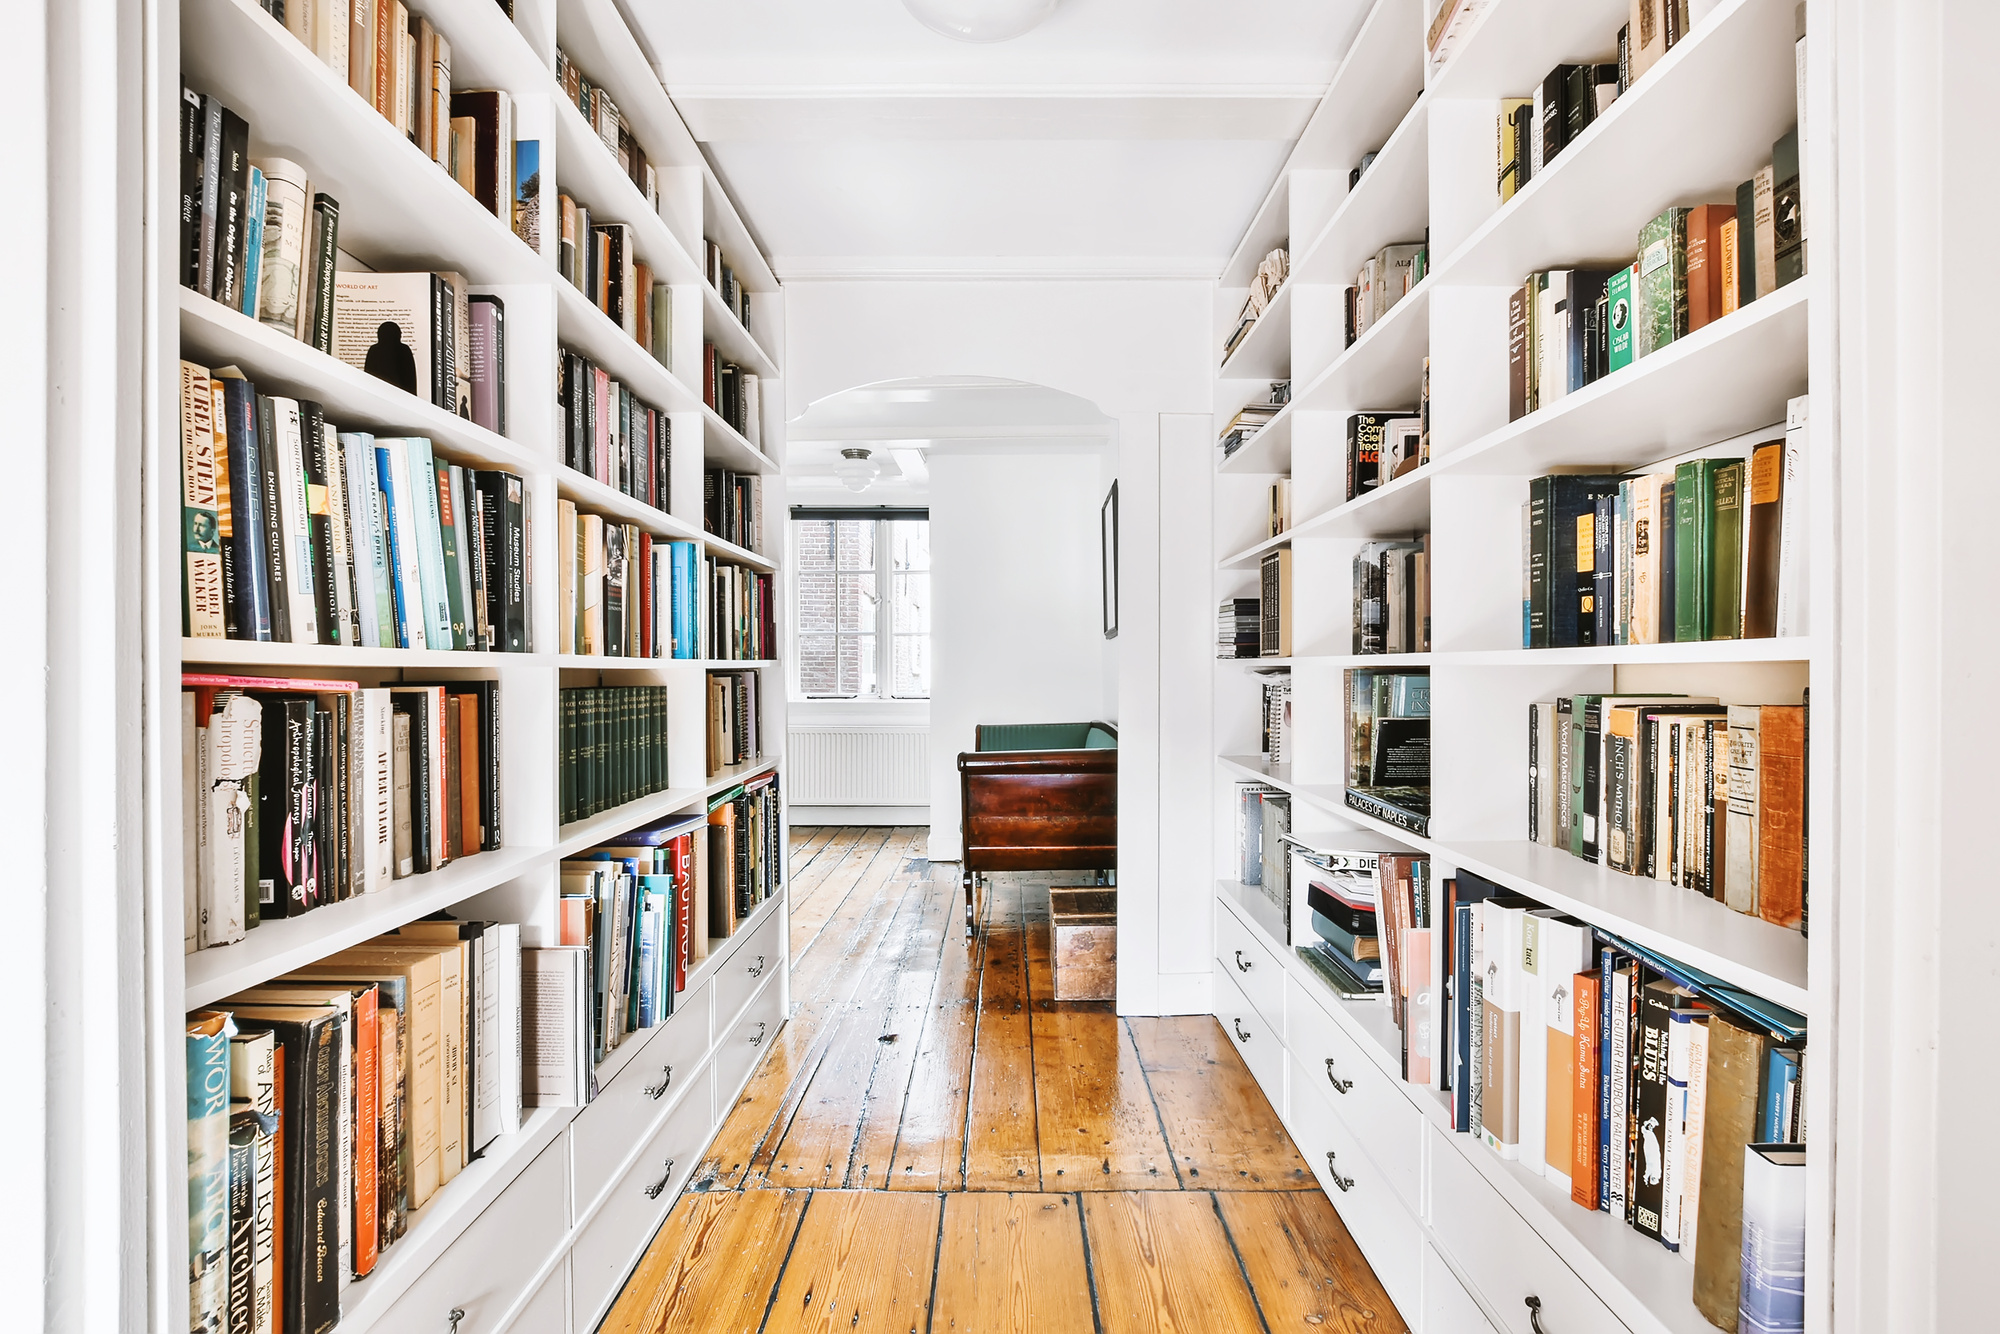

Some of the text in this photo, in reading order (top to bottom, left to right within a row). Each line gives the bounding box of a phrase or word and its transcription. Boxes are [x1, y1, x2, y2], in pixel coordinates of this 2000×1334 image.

[231, 151, 239, 172] Smith
[183, 194, 193, 223] delete
[203, 111, 221, 291] The Mangle Practice Andrew Pickering
[224, 192, 237, 302] On the Origin of Objects
[321, 257, 334, 334] Ethnomethodology
[1612, 332, 1628, 346] OSCAR
[1613, 340, 1628, 354] WILDE
[183, 367, 193, 406] PIONEER
[185, 408, 192, 422] OF
[186, 425, 194, 443] THE
[192, 370, 214, 506] AUREL STEIN
[245, 402, 253, 431] Clifford
[312, 416, 318, 427] IN
[1358, 415, 1375, 425] The
[293, 439, 302, 476] SORTING
[1786, 442, 1800, 482] Goethe
[188, 474, 196, 502] ROAD
[247, 446, 259, 521] ROUTES
[295, 479, 304, 510] THINGS
[327, 441, 342, 554] HOME AND HAREM
[267, 471, 282, 582] EXHIBITING CULTURES
[370, 481, 382, 566] AIRCRAFT STORIES
[1621, 520, 1630, 540] How
[194, 559, 207, 613] WALKER
[207, 560, 220, 618] ANNABEL
[224, 545, 236, 604] Switchbacks
[324, 522, 337, 618] CHARLES NICHOLL
[513, 569, 521, 602] Studies
[1621, 571, 1630, 594] Poem
[305, 718, 314, 781] Anthropological
[340, 742, 348, 790] Anthropology
[289, 720, 303, 863] Anthropological Journeys Thapan
[306, 784, 315, 819] Journeys
[377, 750, 388, 845] AFTER TYLOR
[1349, 794, 1408, 827] PALACES OF NAPLES
[1560, 761, 1569, 828] Masterpieces
[340, 831, 348, 859] Critique
[1359, 859, 1377, 869] DIE
[681, 855, 690, 972] BAUHAUS
[1524, 923, 1535, 967] Koentact
[1603, 958, 1611, 973] Blues
[1578, 999, 1590, 1088] Pop-Up Kama Sutra
[1642, 1025, 1658, 1081] BLUES
[1658, 1030, 1668, 1085] Nothing But the
[257, 1065, 266, 1076] of
[316, 1047, 334, 1187] GREAT ARCHAEOLOGISTS
[384, 1053, 395, 1149] man hunter
[1602, 1074, 1610, 1120] Richard Daniels
[1612, 1018, 1625, 1189] GUITAR HANDBOOK RALPH DENYER
[364, 1048, 373, 1226] PREHISTORIC ANCIENT ART
[1601, 1144, 1609, 1161] Cherry
[231, 1153, 241, 1204] Encyclopedia
[239, 1148, 249, 1207] The Cambridge
[257, 1190, 273, 1266] EGYPT
[316, 1197, 328, 1283] Edward Bacon
[256, 1296, 266, 1331] Malek
